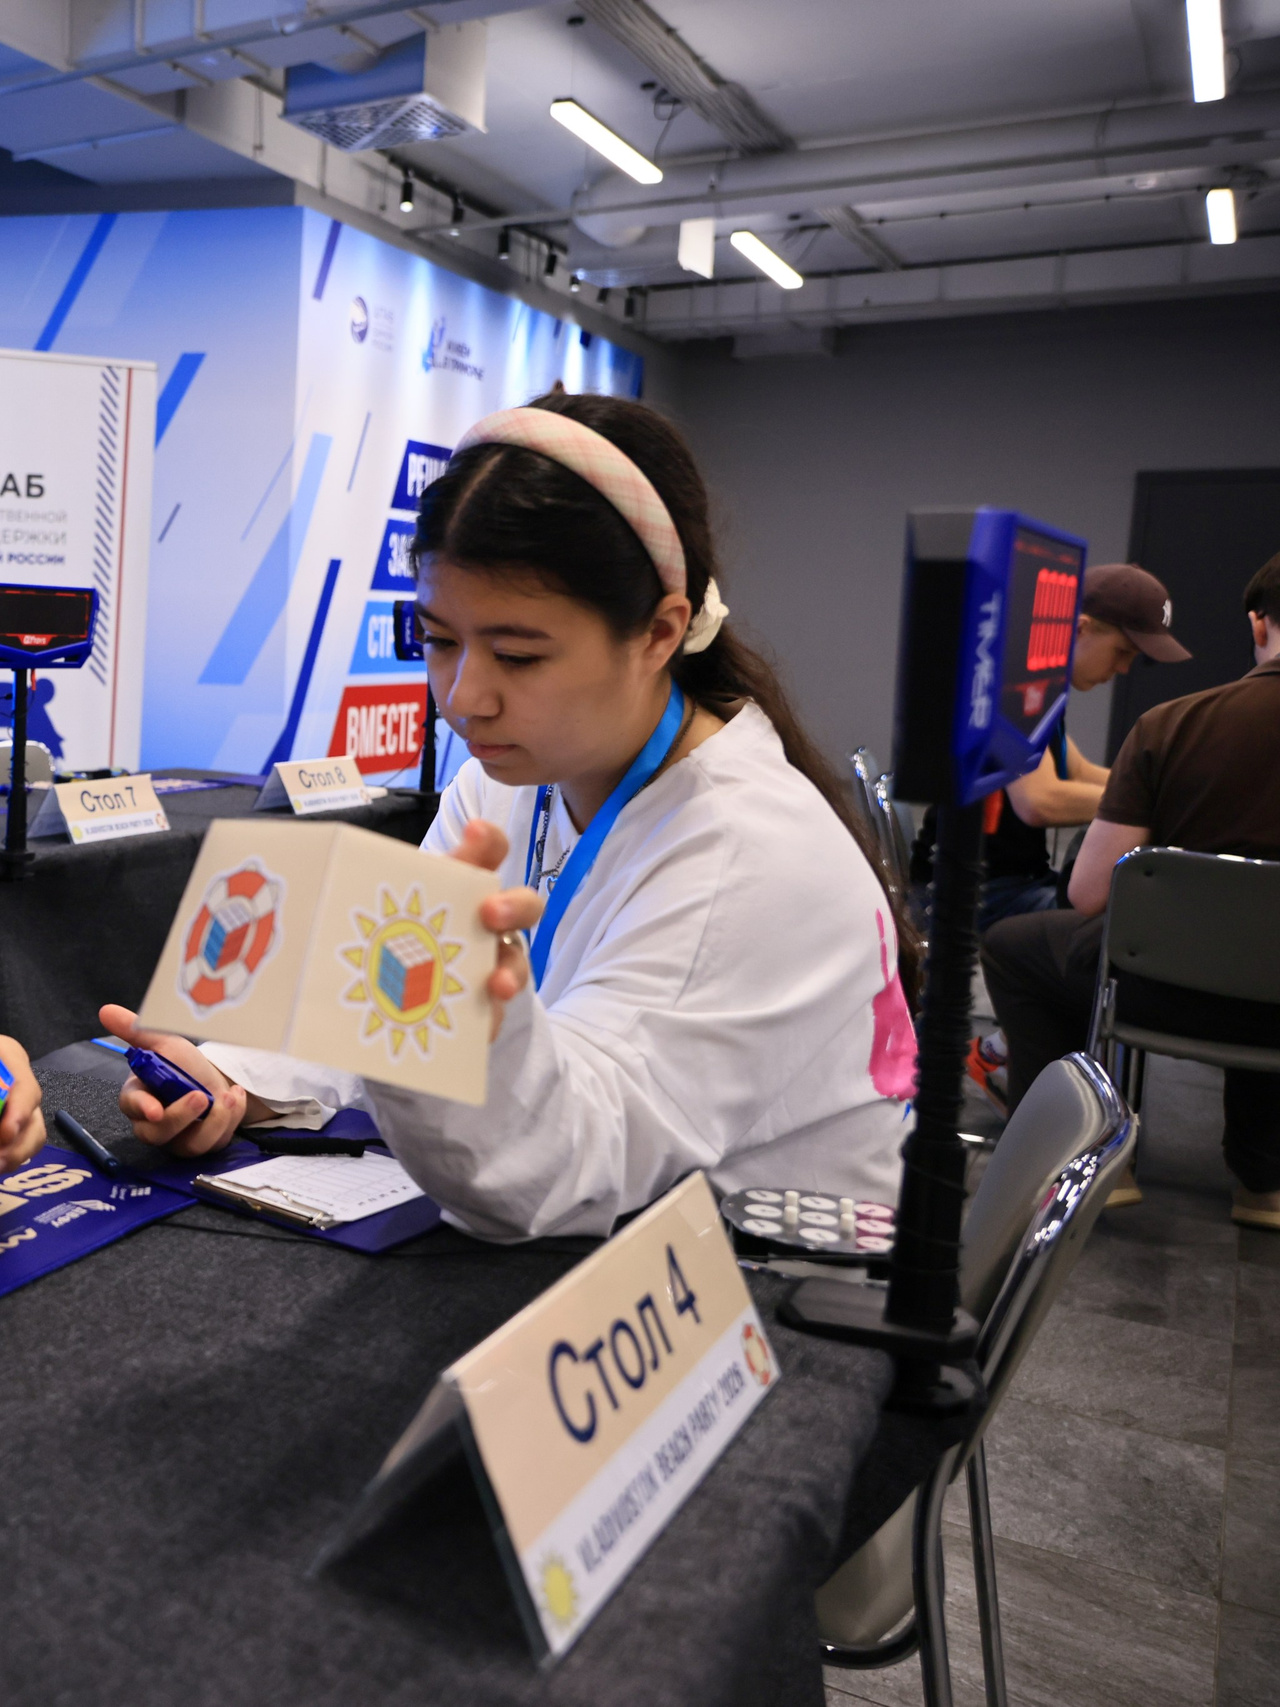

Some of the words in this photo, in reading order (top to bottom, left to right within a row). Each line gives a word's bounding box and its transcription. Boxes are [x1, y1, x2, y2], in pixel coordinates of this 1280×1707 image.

[7, 553, 66, 565] РОССИИ
[346, 701, 420, 759] ВМЕСТЕ
[298, 769, 335, 788] Стол
[334, 766, 346, 784] 8
[80, 789, 126, 812] Стол
[125, 786, 136, 807] 7
[548, 1292, 673, 1444] Стол
[665, 1242, 701, 1324] 4
[653, 1419, 693, 1483] BEACH
[686, 1385, 720, 1444] PARTY
